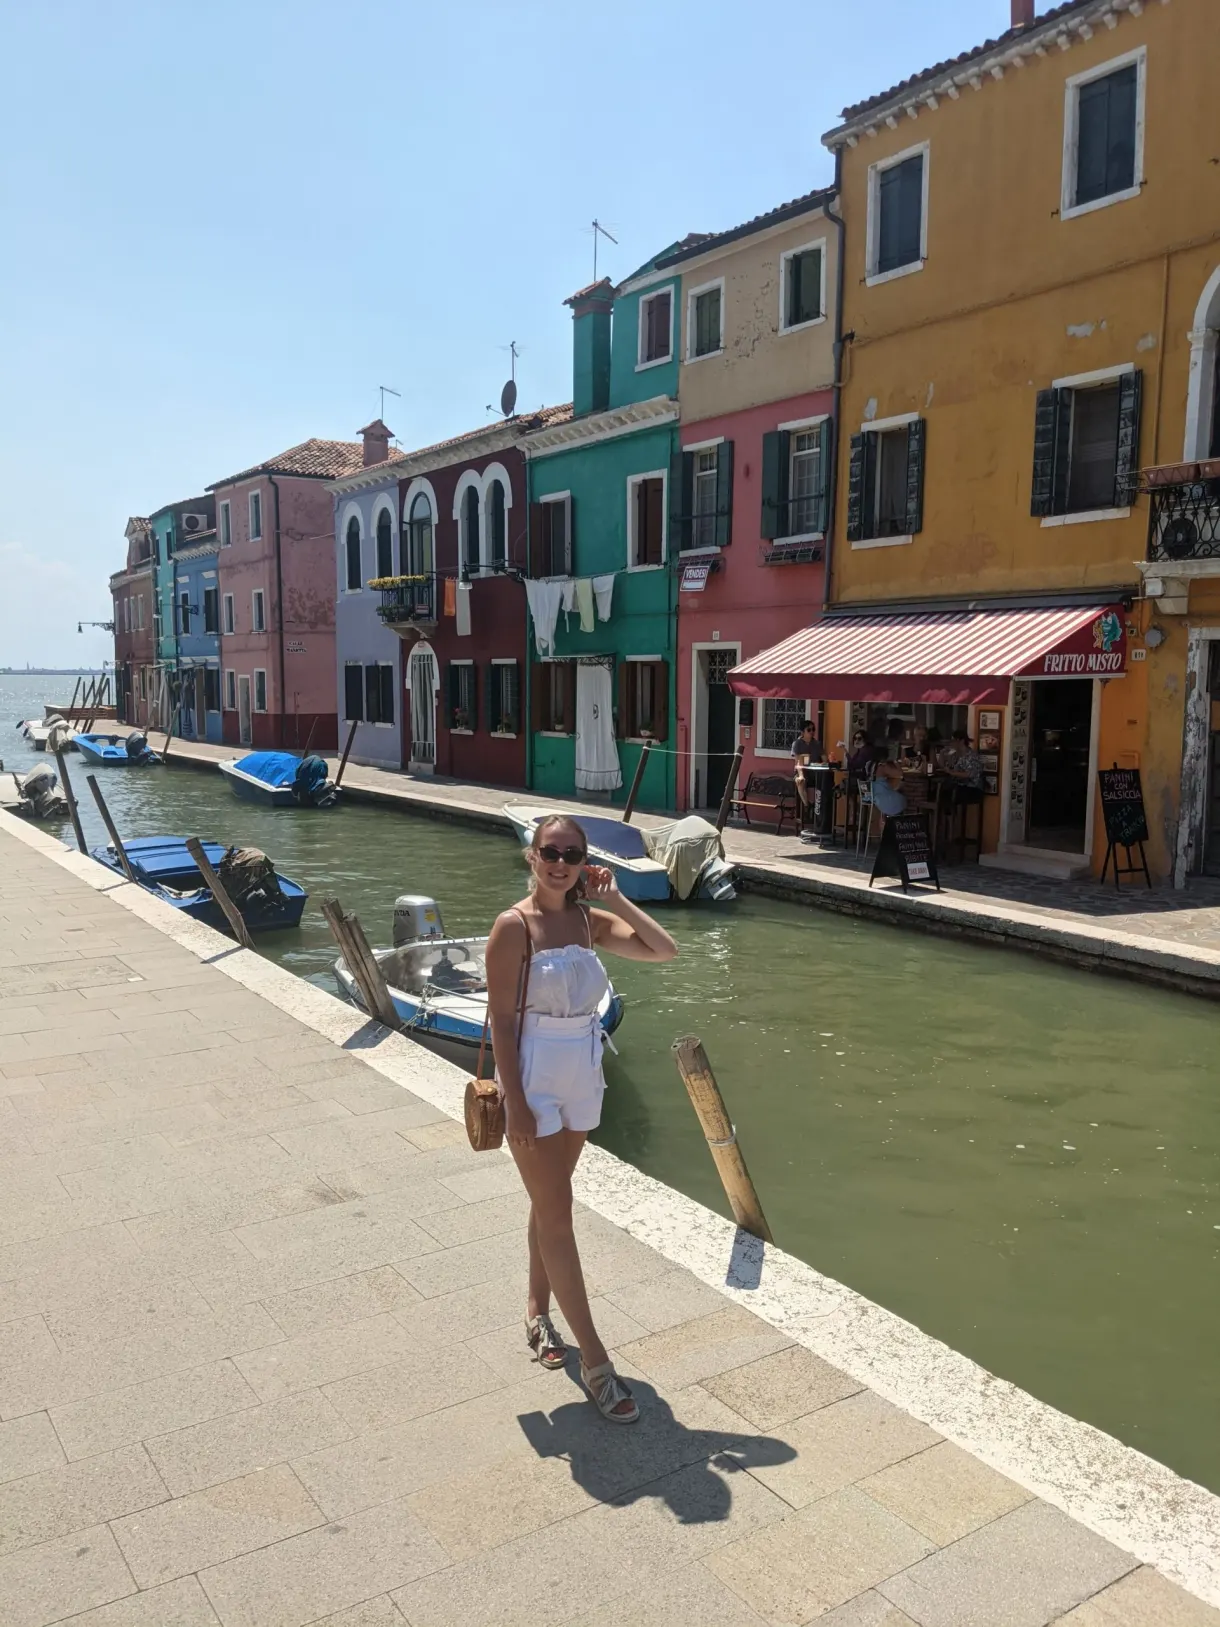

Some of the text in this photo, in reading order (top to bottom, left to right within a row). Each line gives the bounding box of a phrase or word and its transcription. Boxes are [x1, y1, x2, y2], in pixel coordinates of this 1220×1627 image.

[1044, 654, 1085, 672] FRITTO
[1086, 653, 1122, 671] MISTO
[1104, 772, 1134, 783] PANINI
[1103, 790, 1141, 800] SALSICCIA
